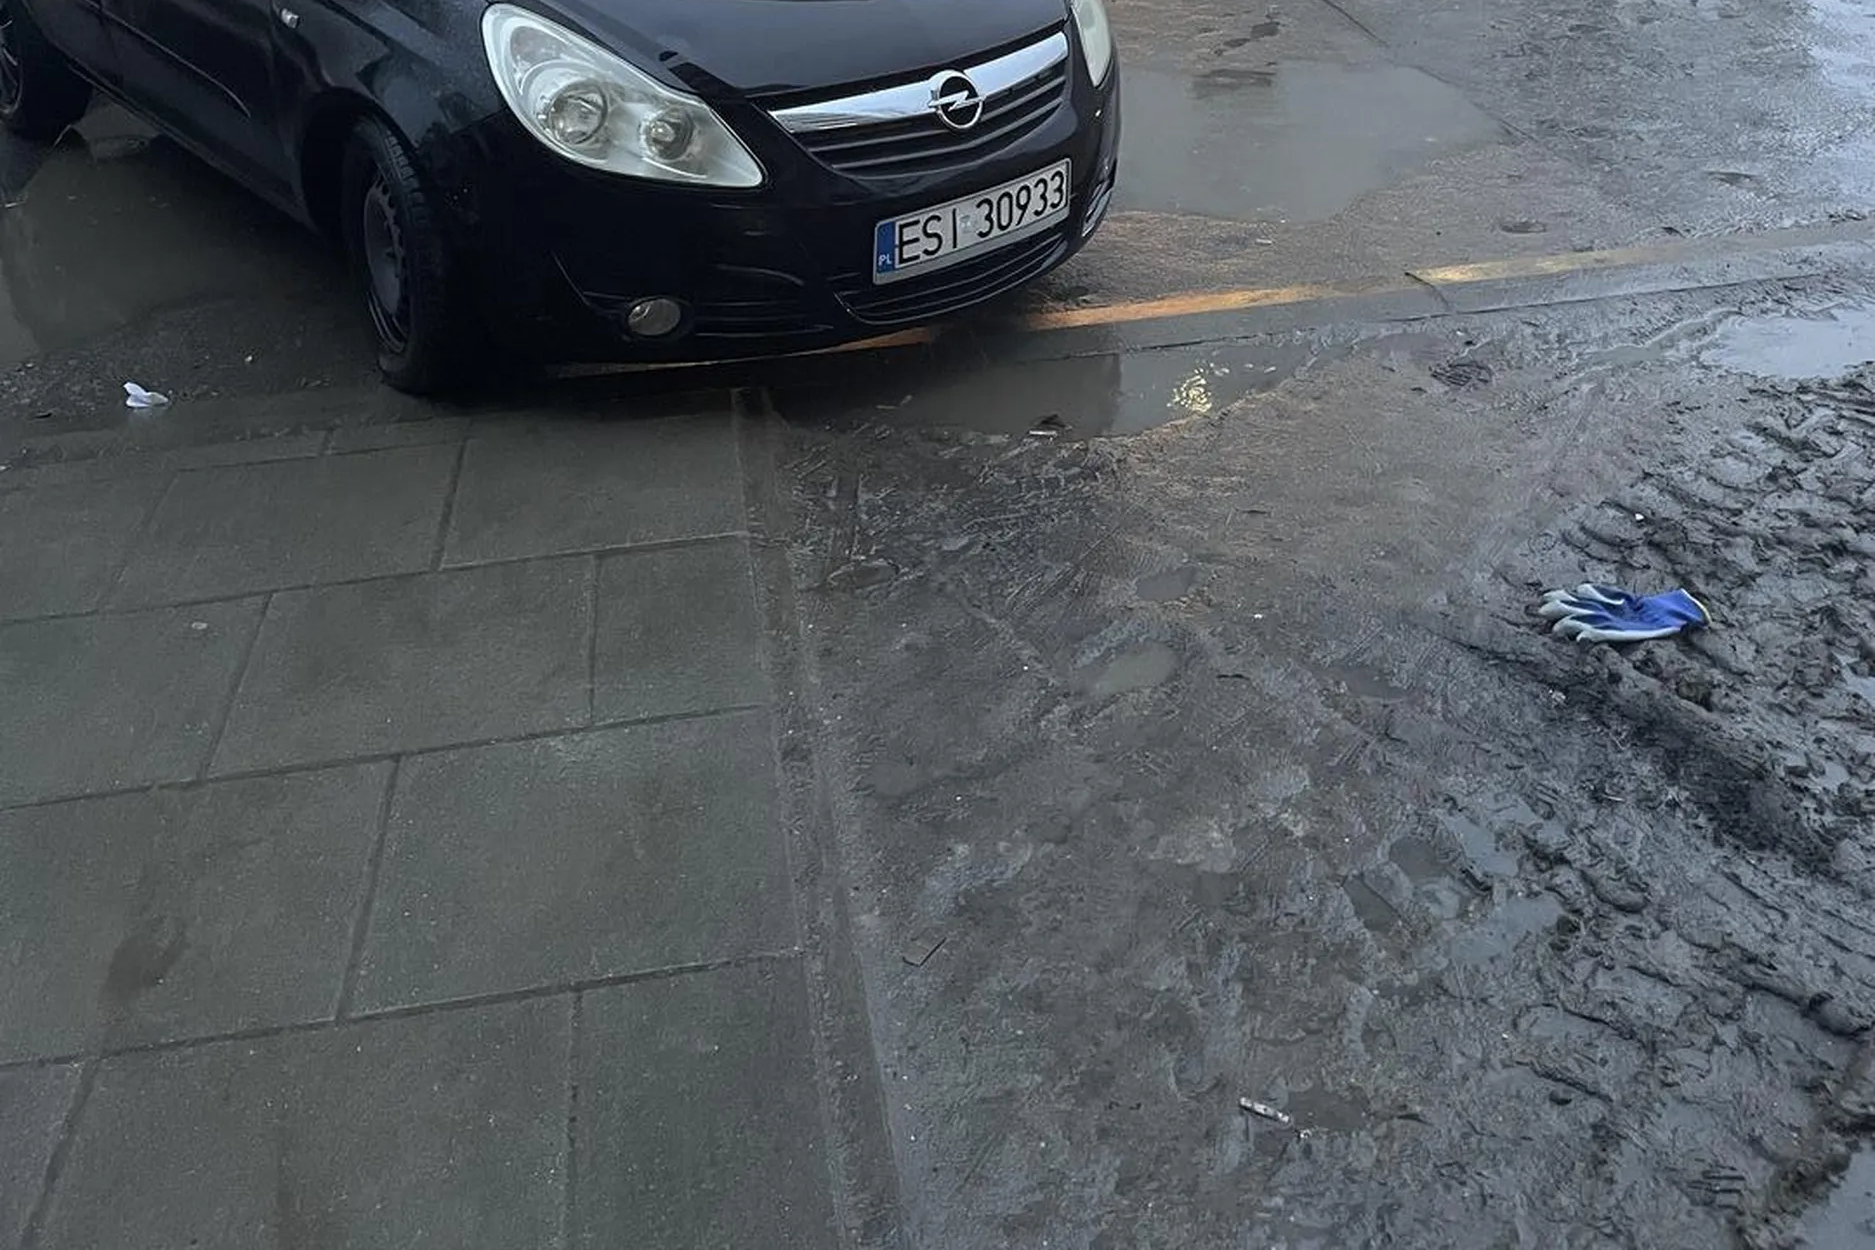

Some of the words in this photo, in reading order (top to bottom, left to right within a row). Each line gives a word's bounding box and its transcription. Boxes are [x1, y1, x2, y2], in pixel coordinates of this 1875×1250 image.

[897, 207, 958, 265] ESI
[976, 170, 1065, 238] 30933
[878, 253, 892, 266] PL
